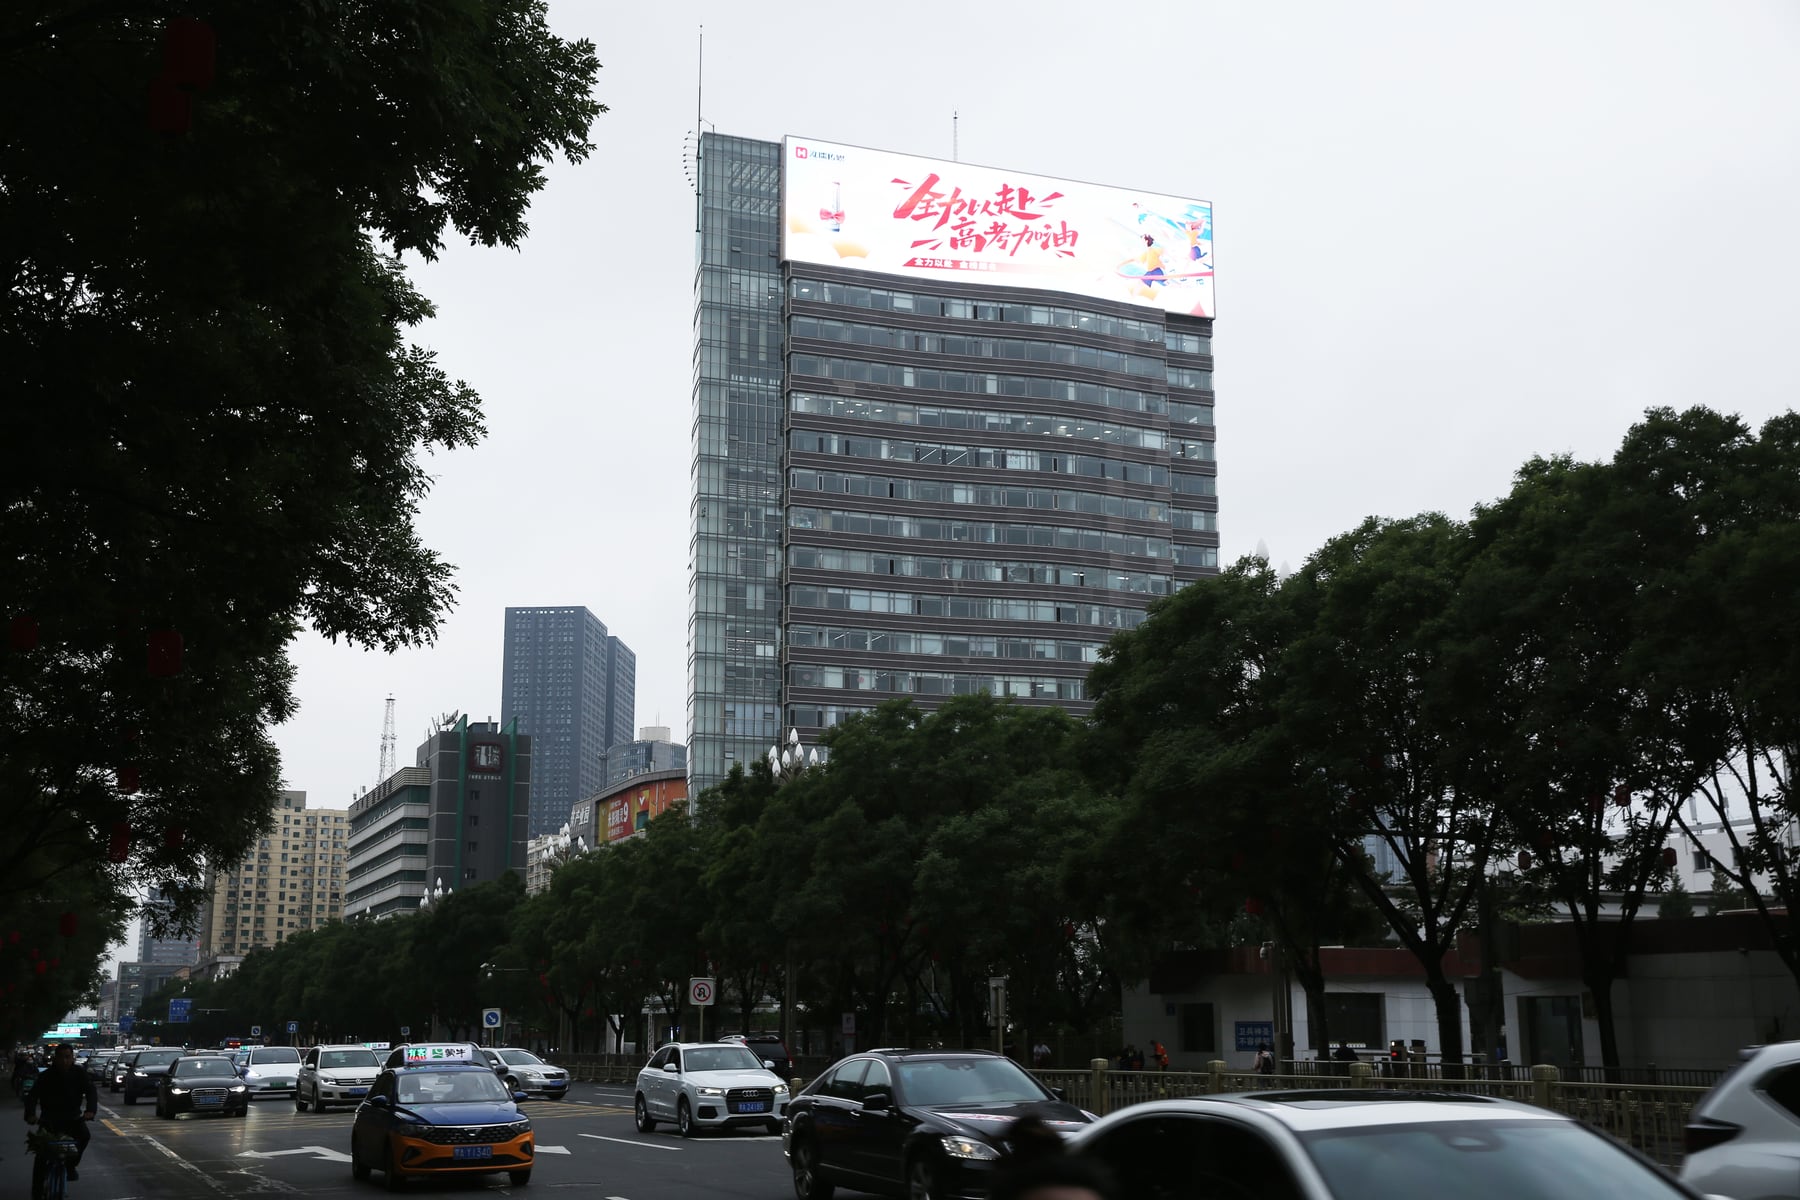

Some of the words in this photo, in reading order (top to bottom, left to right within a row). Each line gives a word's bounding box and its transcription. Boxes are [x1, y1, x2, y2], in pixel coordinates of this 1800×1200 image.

[893, 173, 1045, 231] 全力以赴
[950, 216, 1079, 256] 高考加油
